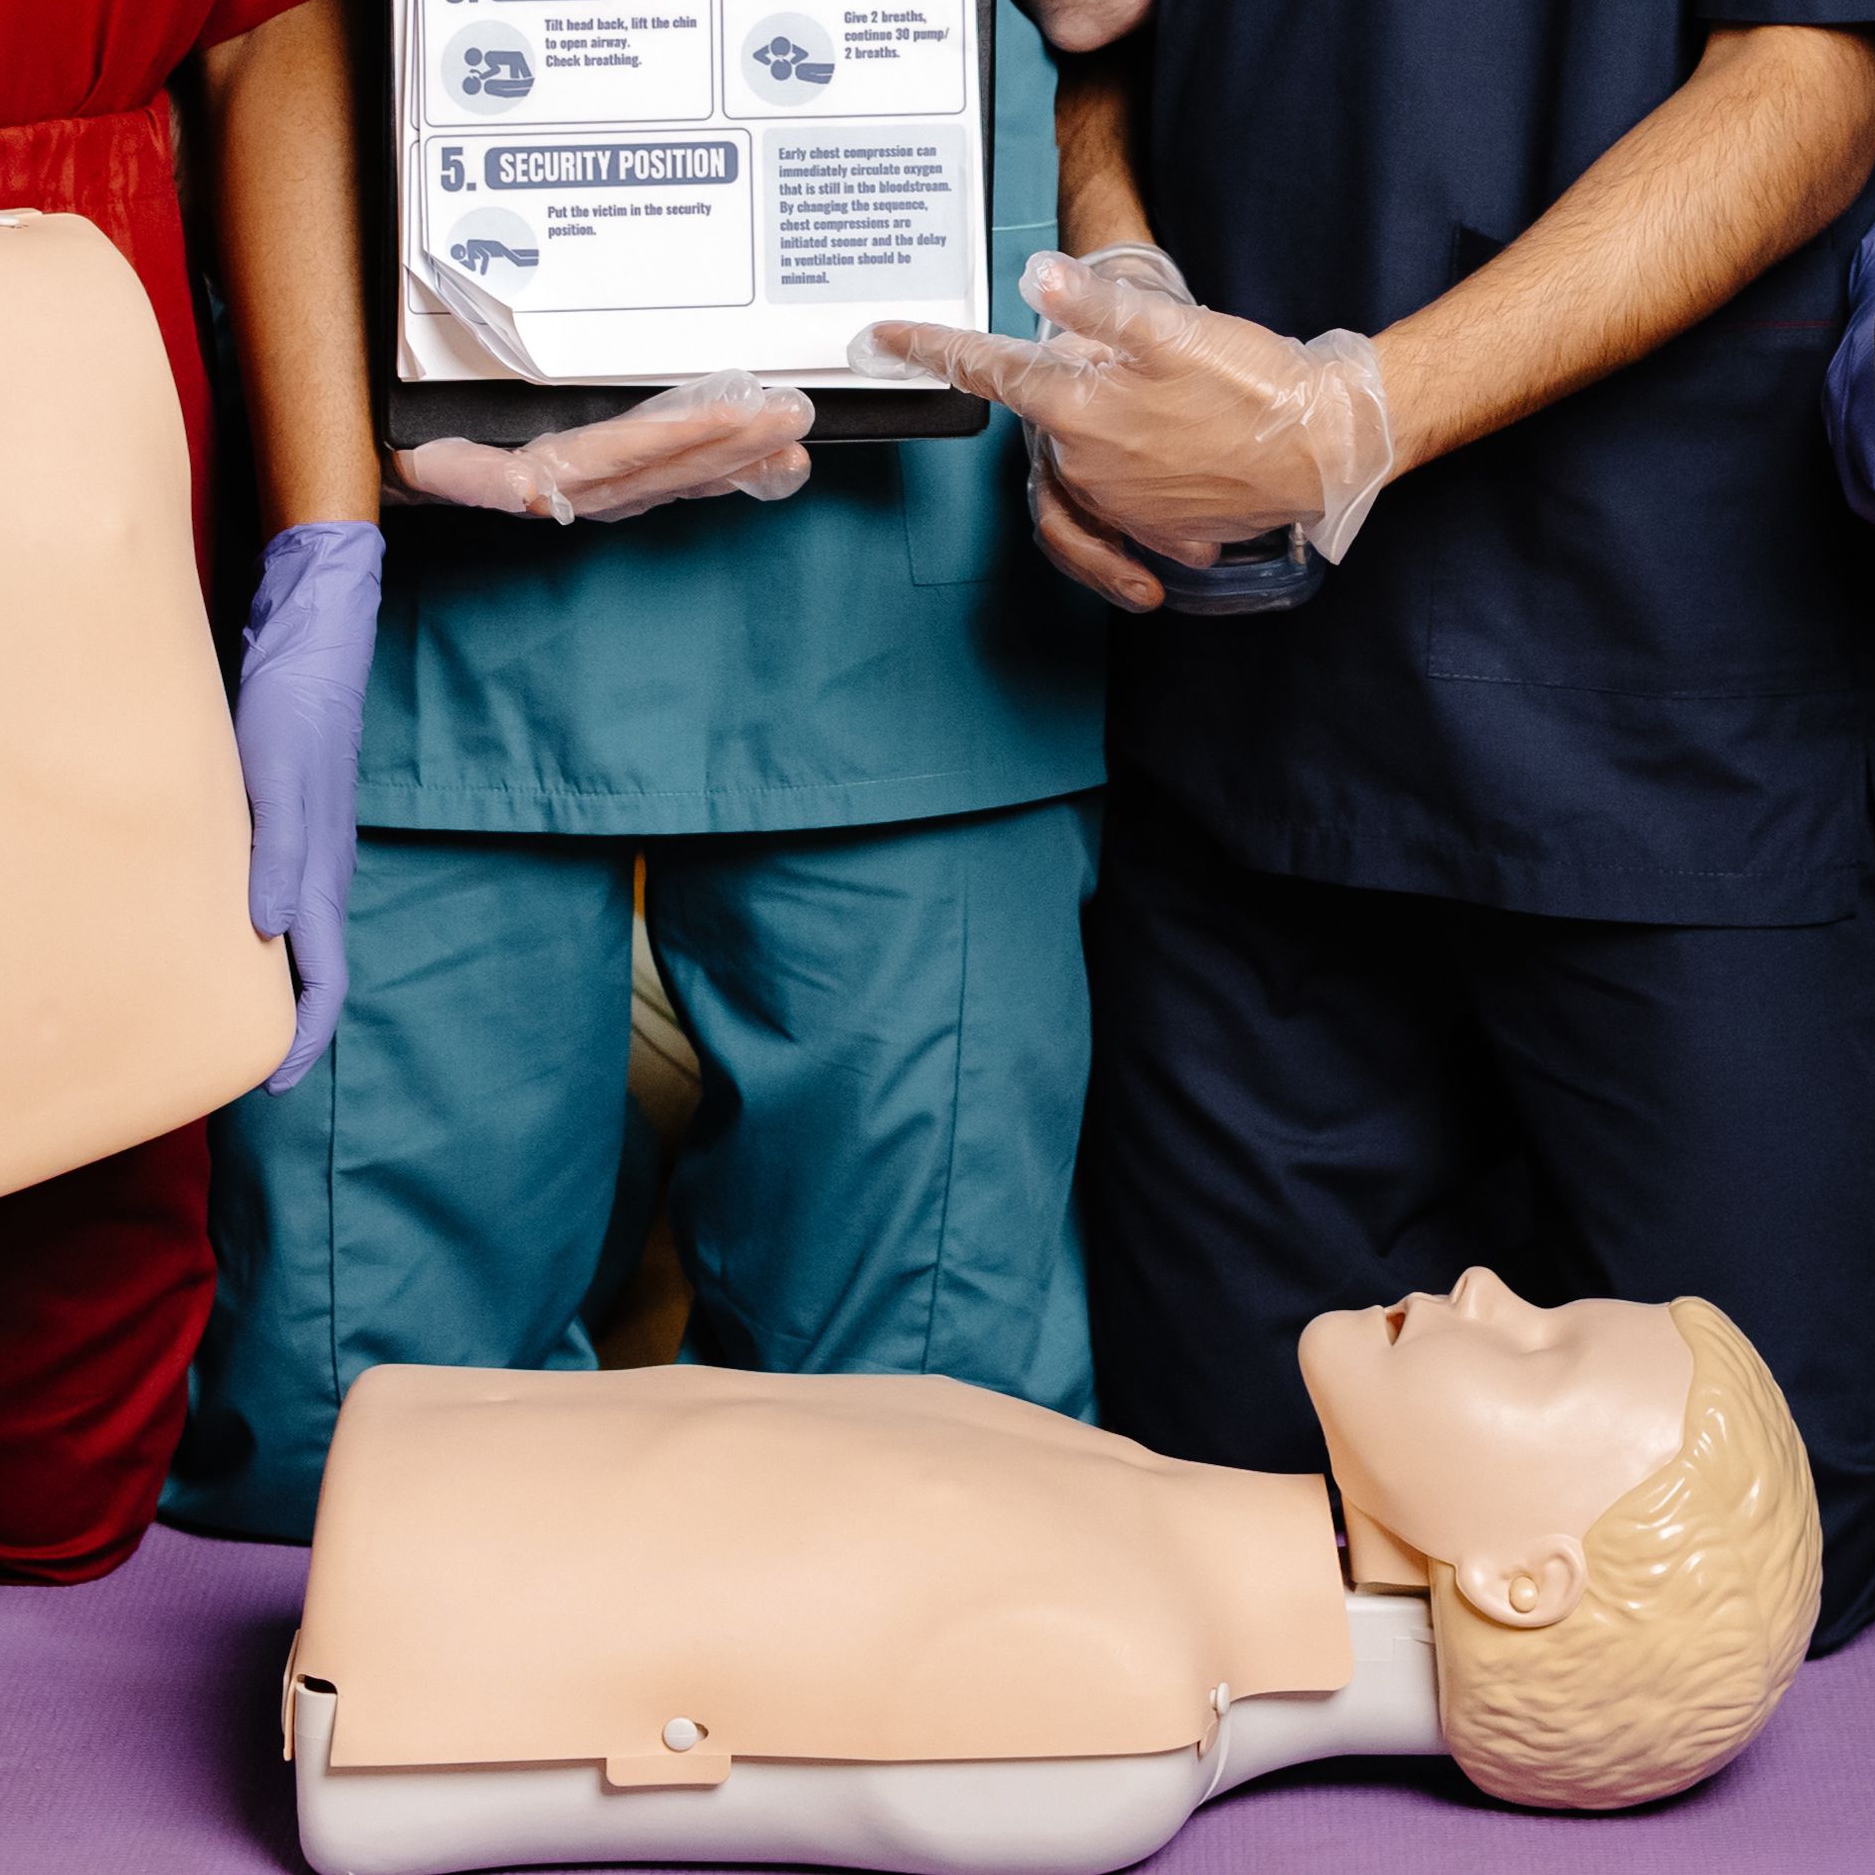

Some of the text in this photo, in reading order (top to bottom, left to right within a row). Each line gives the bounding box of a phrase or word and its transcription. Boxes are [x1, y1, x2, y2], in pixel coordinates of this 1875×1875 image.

[545, 16, 696, 31] Tilt head back, lift the chin
[844, 10, 926, 24] Give 2 breaths,
[844, 28, 949, 42] continue 30 pump/
[545, 36, 630, 52] to open airway.
[845, 47, 900, 59] 2 breaths.
[546, 54, 642, 68] Check breathing.
[779, 145, 936, 161] Early chest compression can
[440, 146, 725, 192] 5. SECURITY POSITION
[779, 164, 942, 178] immediately circulate oxygen
[780, 180, 952, 195] that is still in the bloodstream.
[547, 203, 711, 218] Put the victim in the security
[780, 199, 928, 214] By changing the sequence,
[548, 224, 596, 239] position.
[780, 217, 911, 231] chest compressions are
[781, 233, 946, 249] initiated sooner and the delay
[781, 252, 911, 267] in ventilation should be
[782, 272, 829, 285] minimal.
